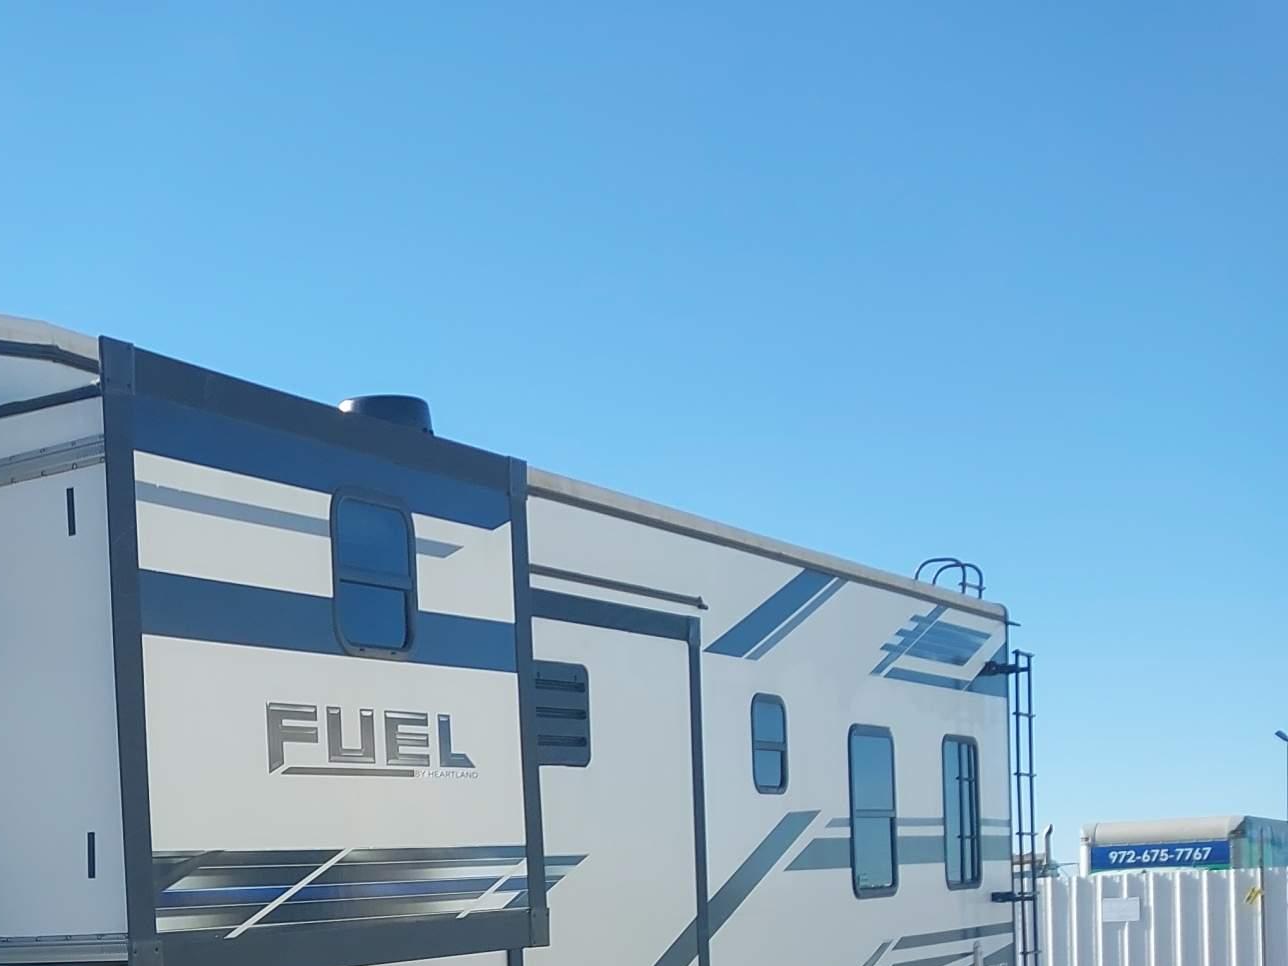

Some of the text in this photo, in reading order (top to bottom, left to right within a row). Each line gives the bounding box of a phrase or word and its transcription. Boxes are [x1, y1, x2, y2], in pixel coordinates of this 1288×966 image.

[266, 701, 476, 774] FUEL
[428, 769, 479, 779] HEARTLAND
[1108, 847, 1212, 864] 972-675-7767
